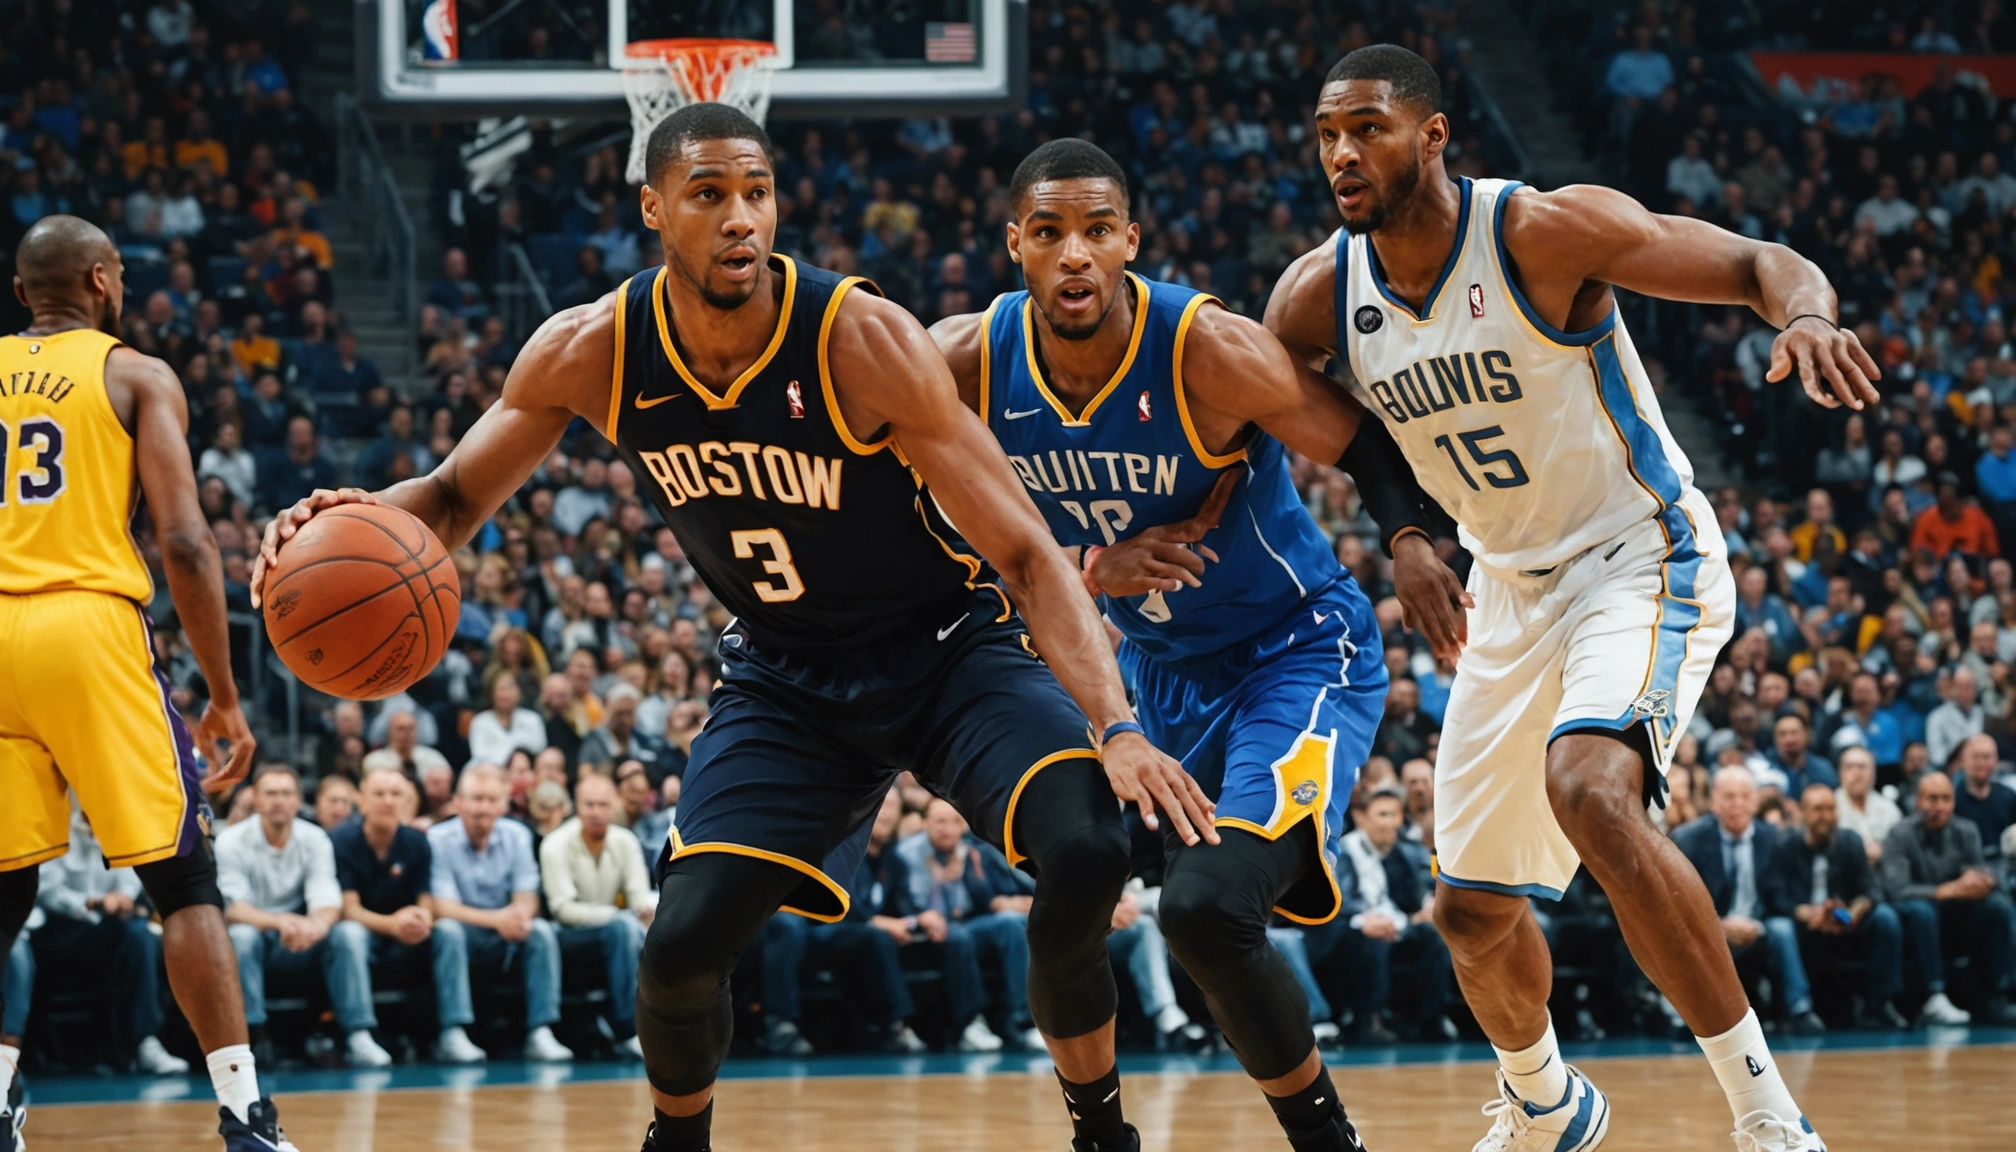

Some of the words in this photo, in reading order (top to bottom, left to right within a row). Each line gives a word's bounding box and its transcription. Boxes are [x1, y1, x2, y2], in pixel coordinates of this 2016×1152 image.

[638, 441, 843, 511] BOSTOW
[1434, 425, 1530, 491] 15
[730, 527, 806, 603] 3
